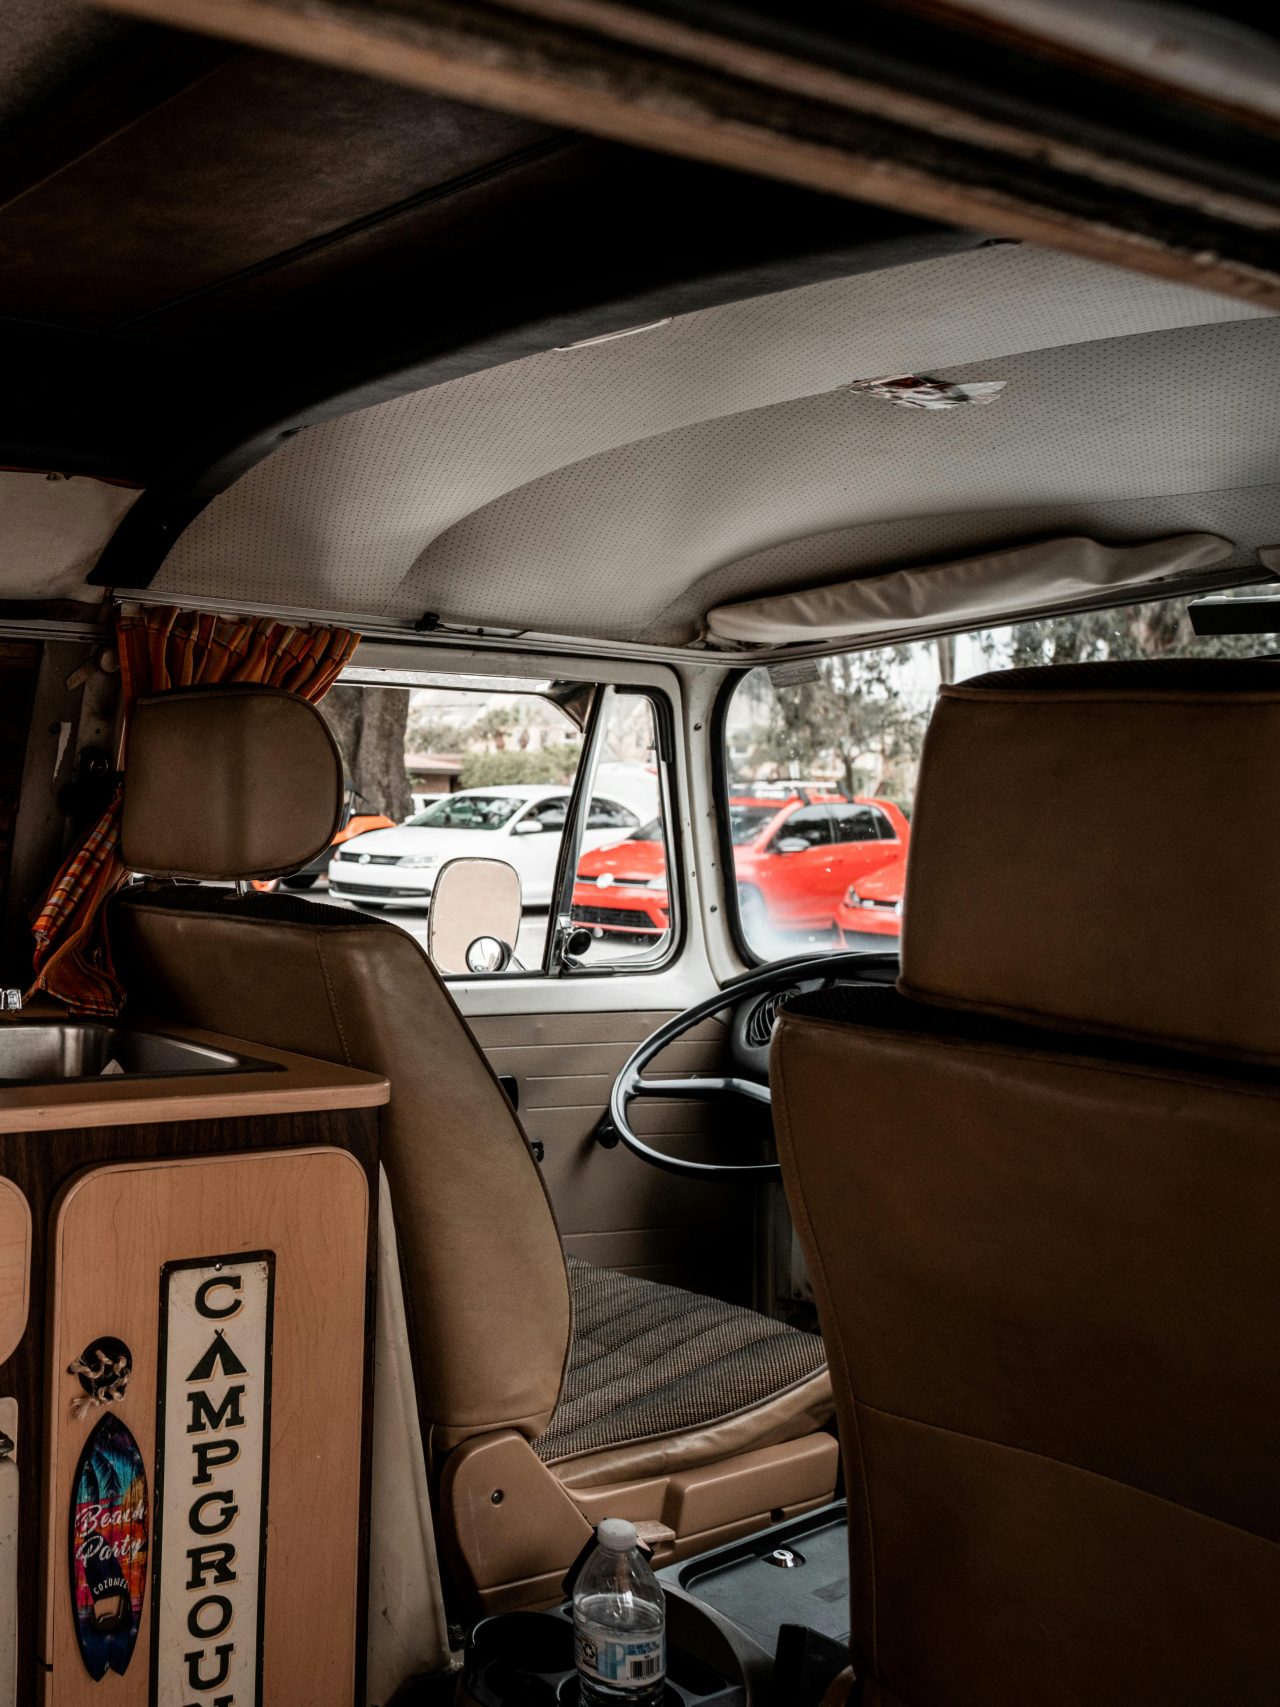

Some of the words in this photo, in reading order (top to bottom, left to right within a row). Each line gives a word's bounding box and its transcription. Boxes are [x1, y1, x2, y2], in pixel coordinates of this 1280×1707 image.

[185, 1275, 247, 1707] CAMPGROU
[75, 1499, 146, 1537] Beach
[76, 1534, 144, 1568] Party
